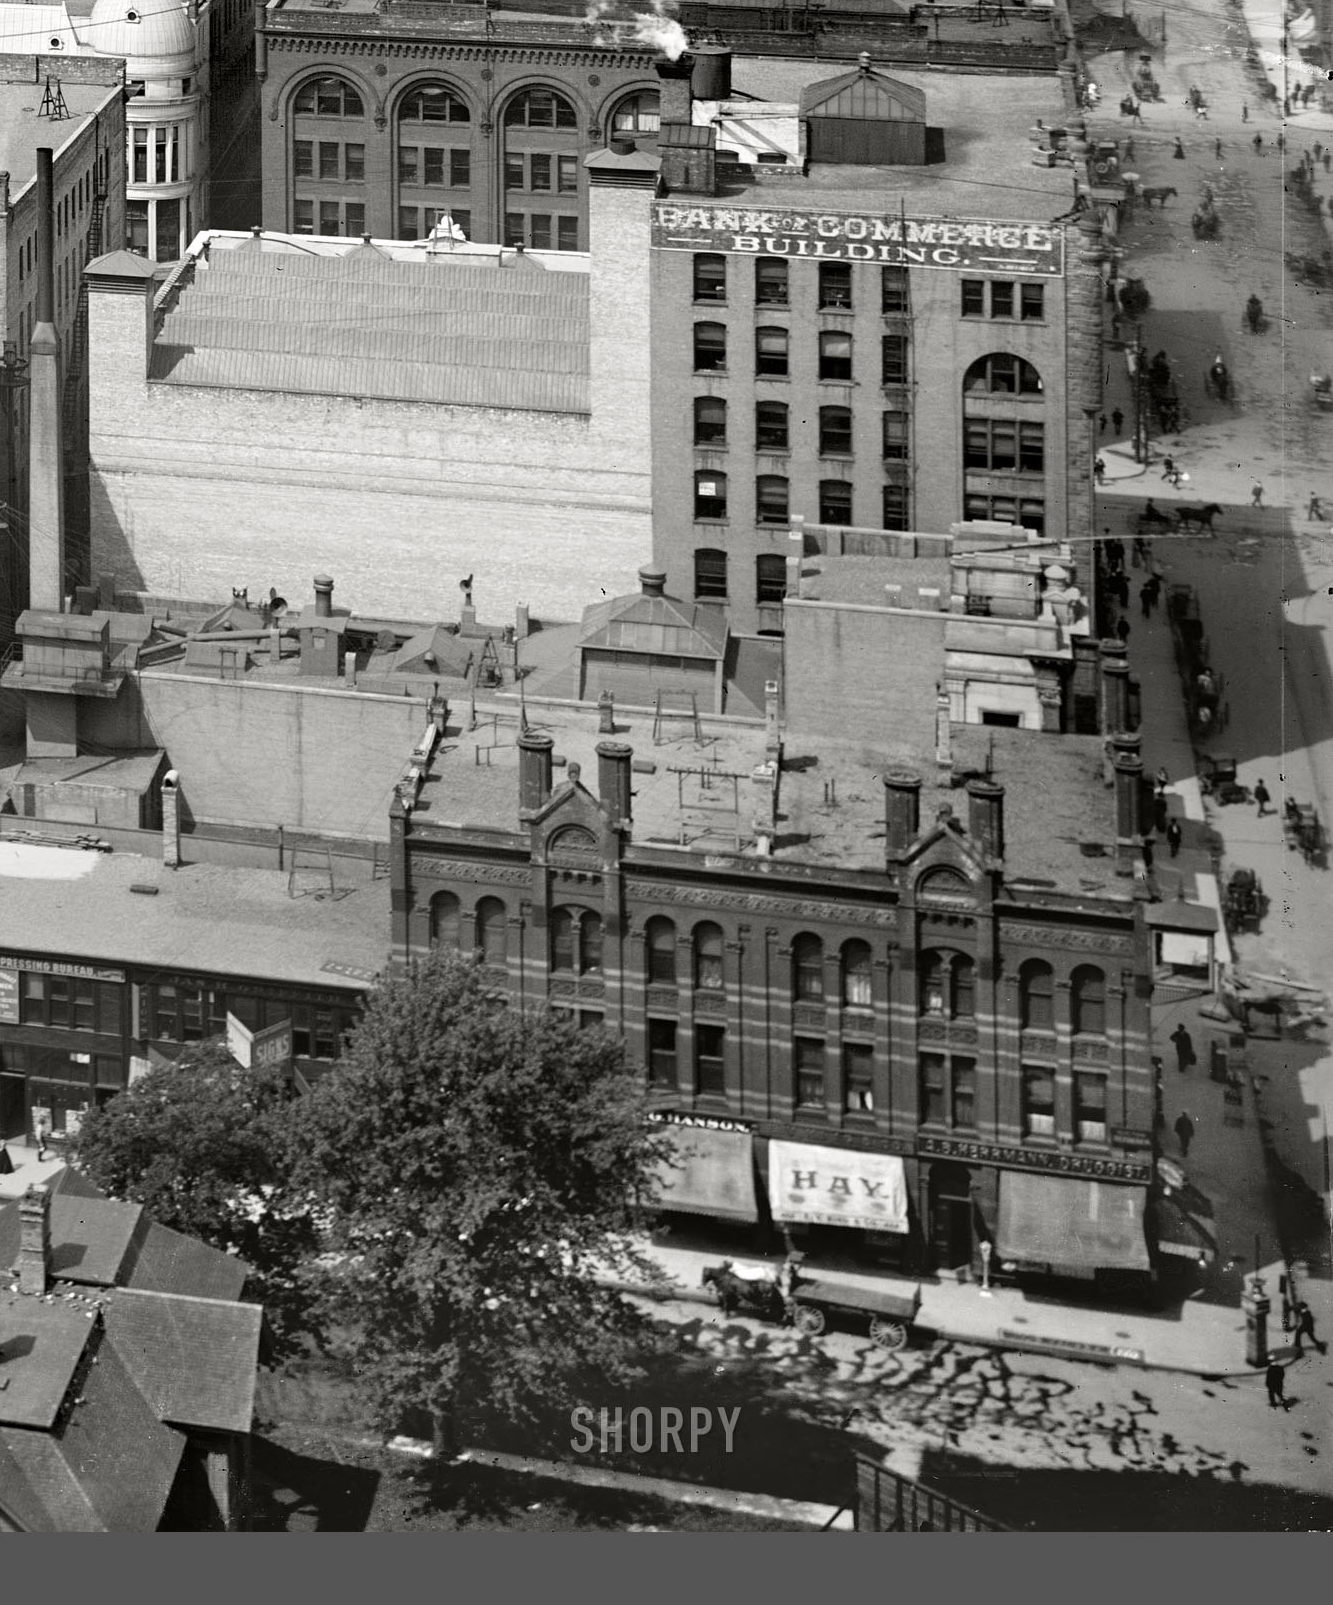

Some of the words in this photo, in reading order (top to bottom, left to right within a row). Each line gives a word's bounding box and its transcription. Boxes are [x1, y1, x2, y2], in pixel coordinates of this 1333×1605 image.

[658, 206, 774, 234] BANK
[816, 214, 1054, 251] COMMERCE
[730, 234, 971, 266] BUILDING.
[0, 957, 51, 972] PRESSING
[256, 1034, 290, 1062] SIGNS
